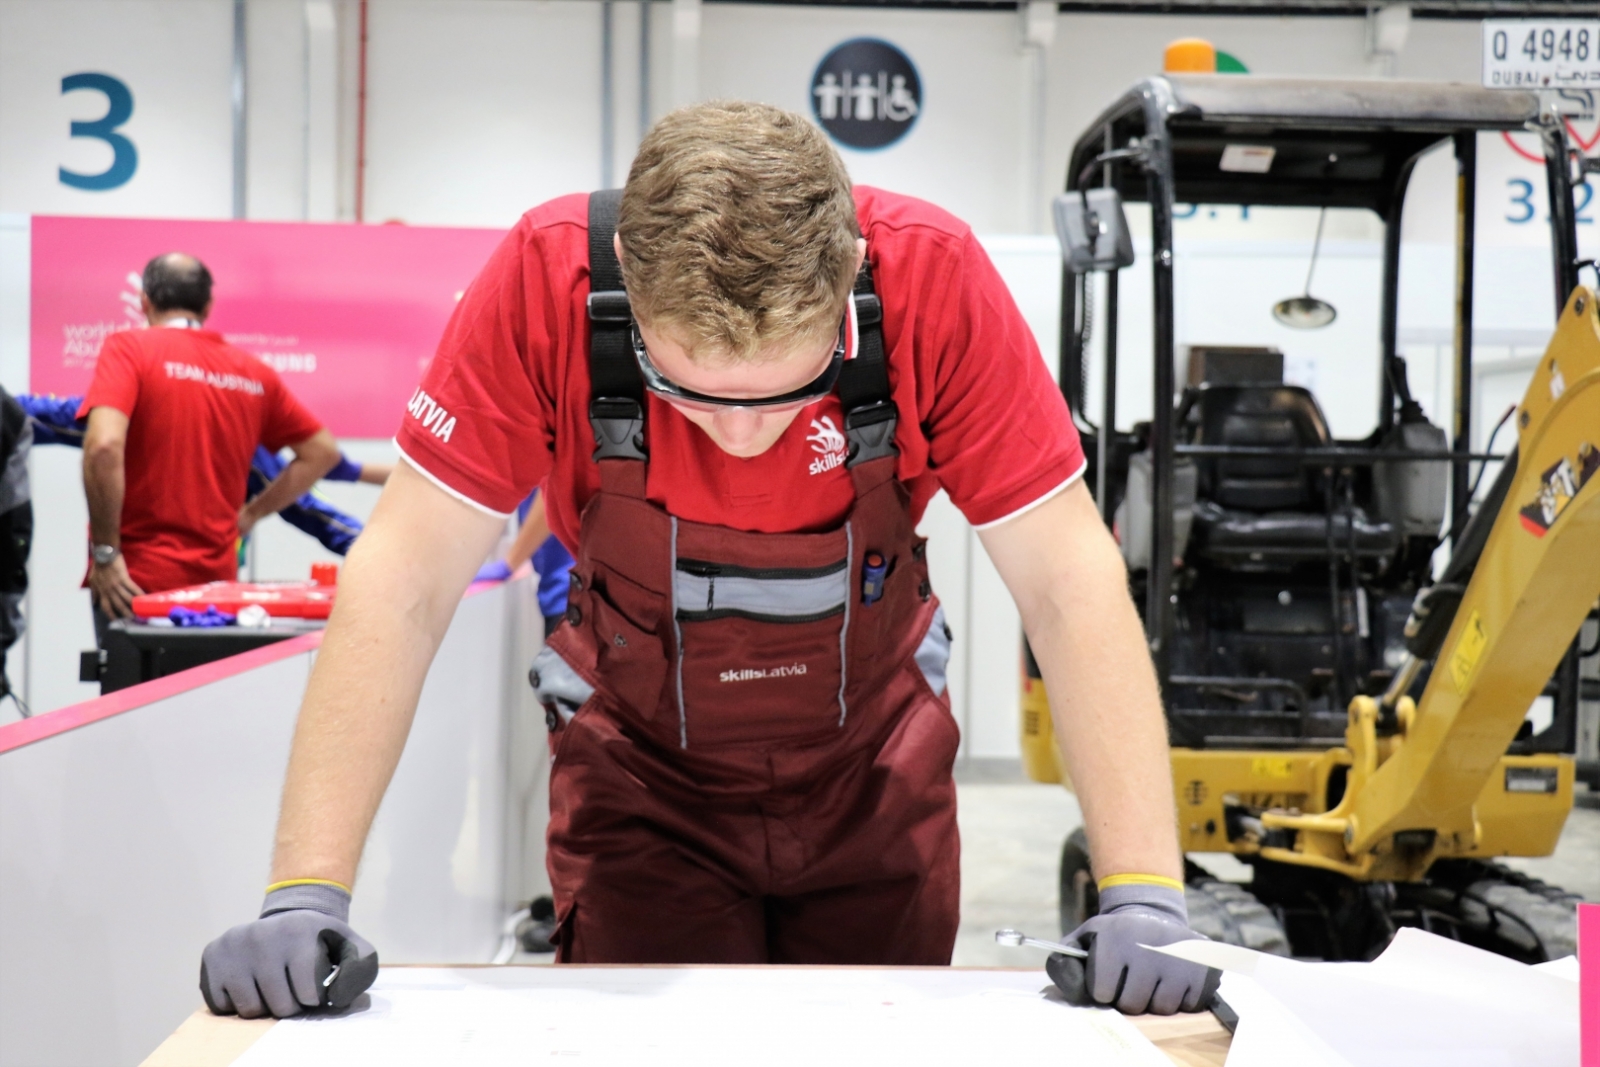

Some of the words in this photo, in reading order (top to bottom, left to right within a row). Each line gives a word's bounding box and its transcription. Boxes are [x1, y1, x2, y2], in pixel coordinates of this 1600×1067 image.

[1493, 31, 1508, 60] Q
[1522, 28, 1600, 61] 4948
[1492, 71, 1539, 84] DUBAI
[58, 72, 138, 191] 3
[164, 361, 205, 380] TEAM
[206, 371, 265, 396] AUSTRIA
[809, 449, 850, 476] skills
[719, 662, 807, 682] skillsLatvia
